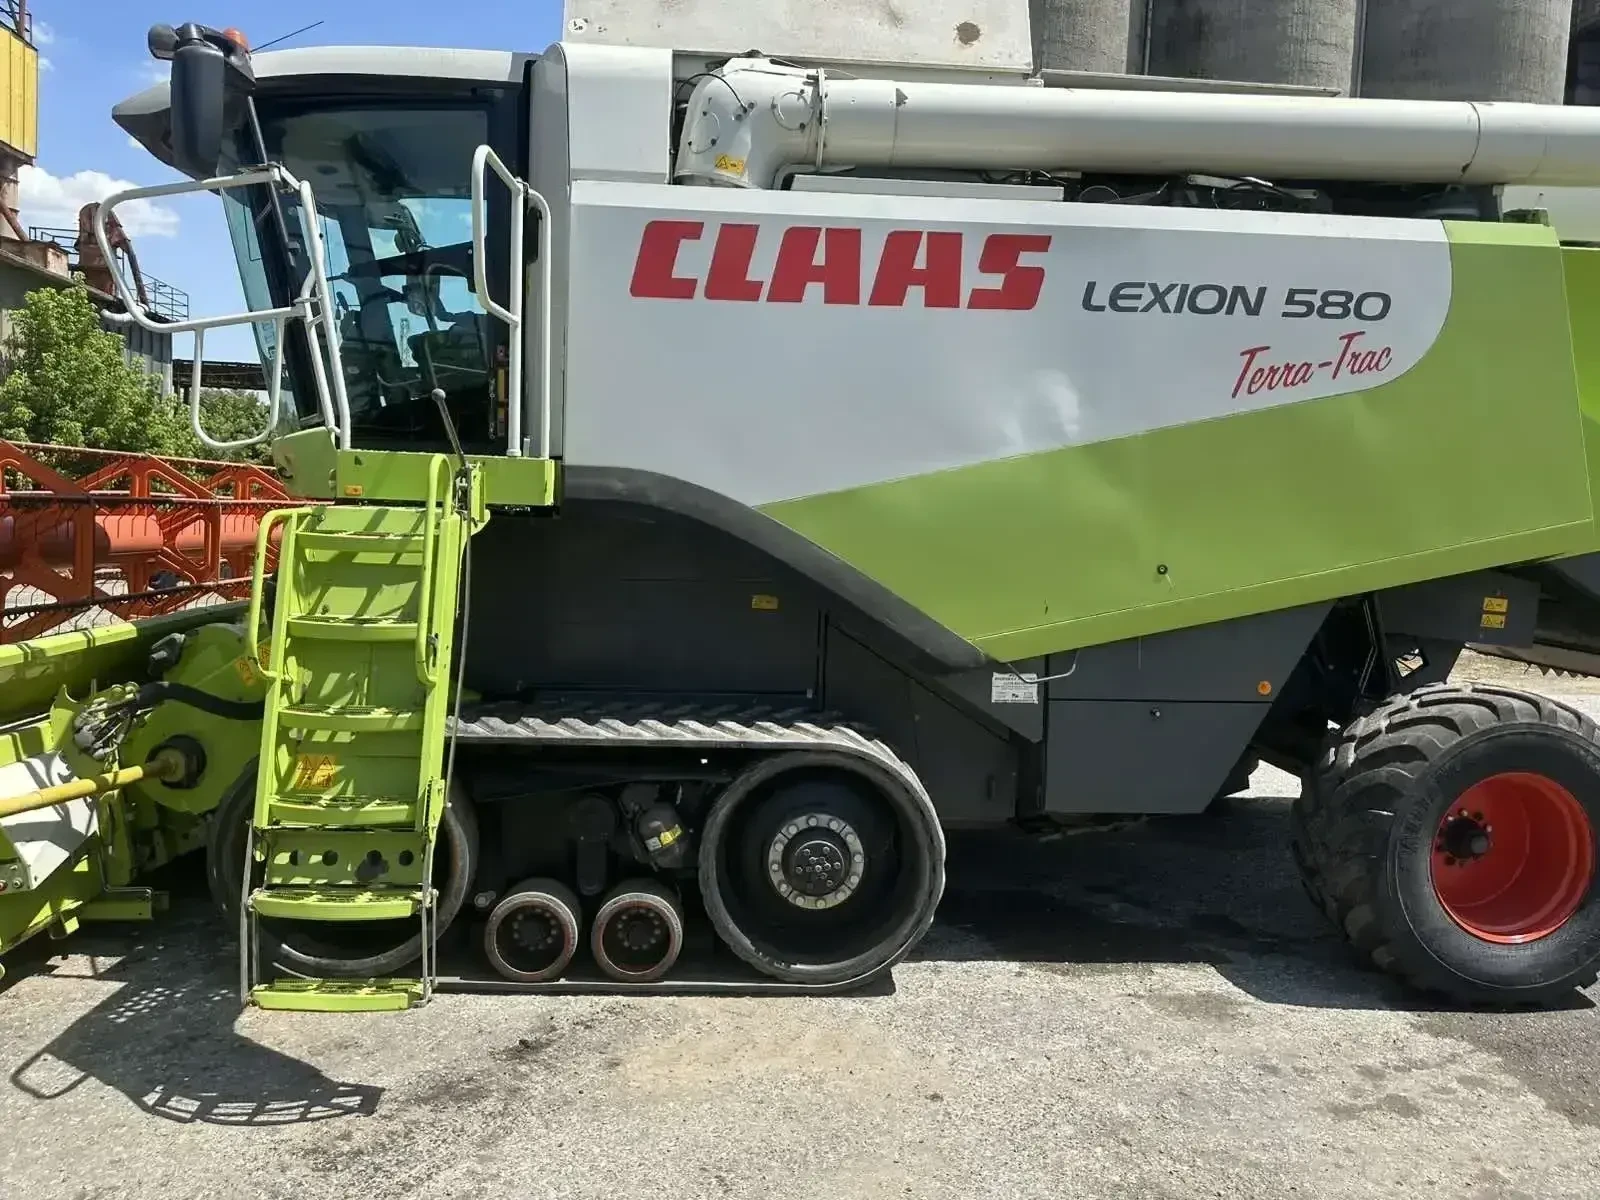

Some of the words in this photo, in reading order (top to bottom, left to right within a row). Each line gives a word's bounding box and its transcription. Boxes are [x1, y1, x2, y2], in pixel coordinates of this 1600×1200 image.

[630, 220, 1052, 311] CLAAS
[1082, 280, 1267, 317] LEXION
[1280, 287, 1392, 322] 580
[1231, 331, 1393, 398] Terra-Trac
